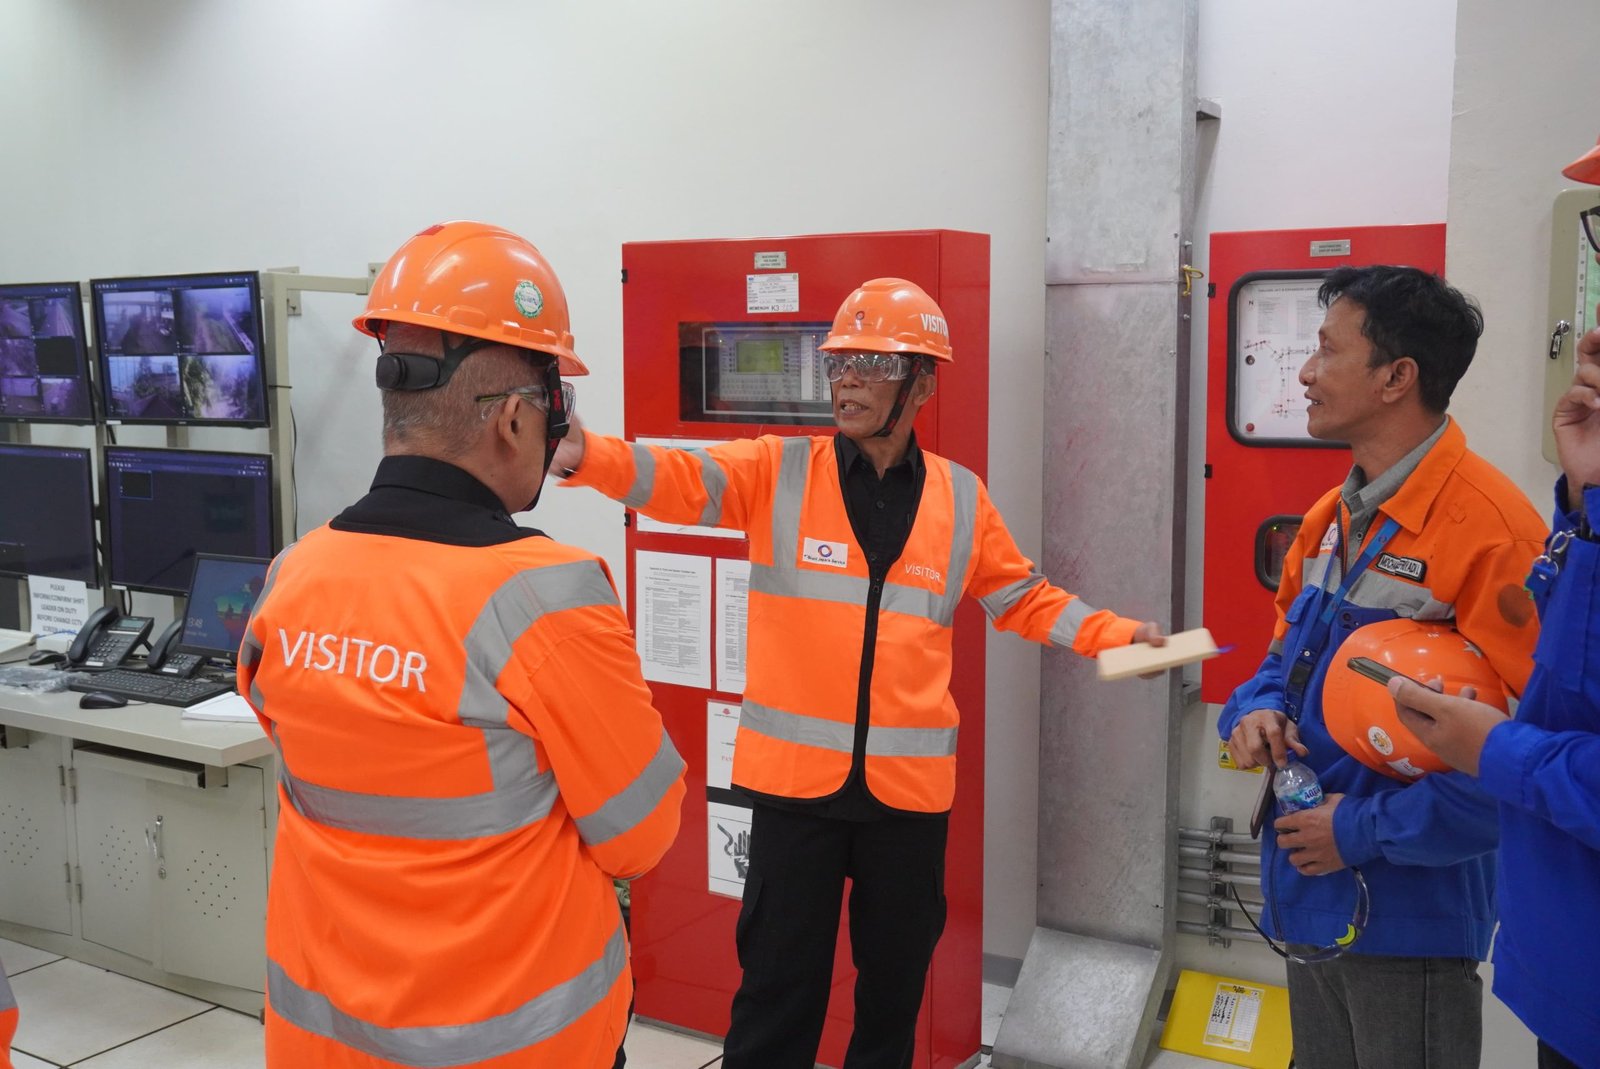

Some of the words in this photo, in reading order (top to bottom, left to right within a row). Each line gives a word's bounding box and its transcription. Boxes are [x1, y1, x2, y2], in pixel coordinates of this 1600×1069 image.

[920, 313, 949, 337] VISITO
[905, 563, 941, 582] VISITOR
[278, 628, 428, 693] VISITOR
